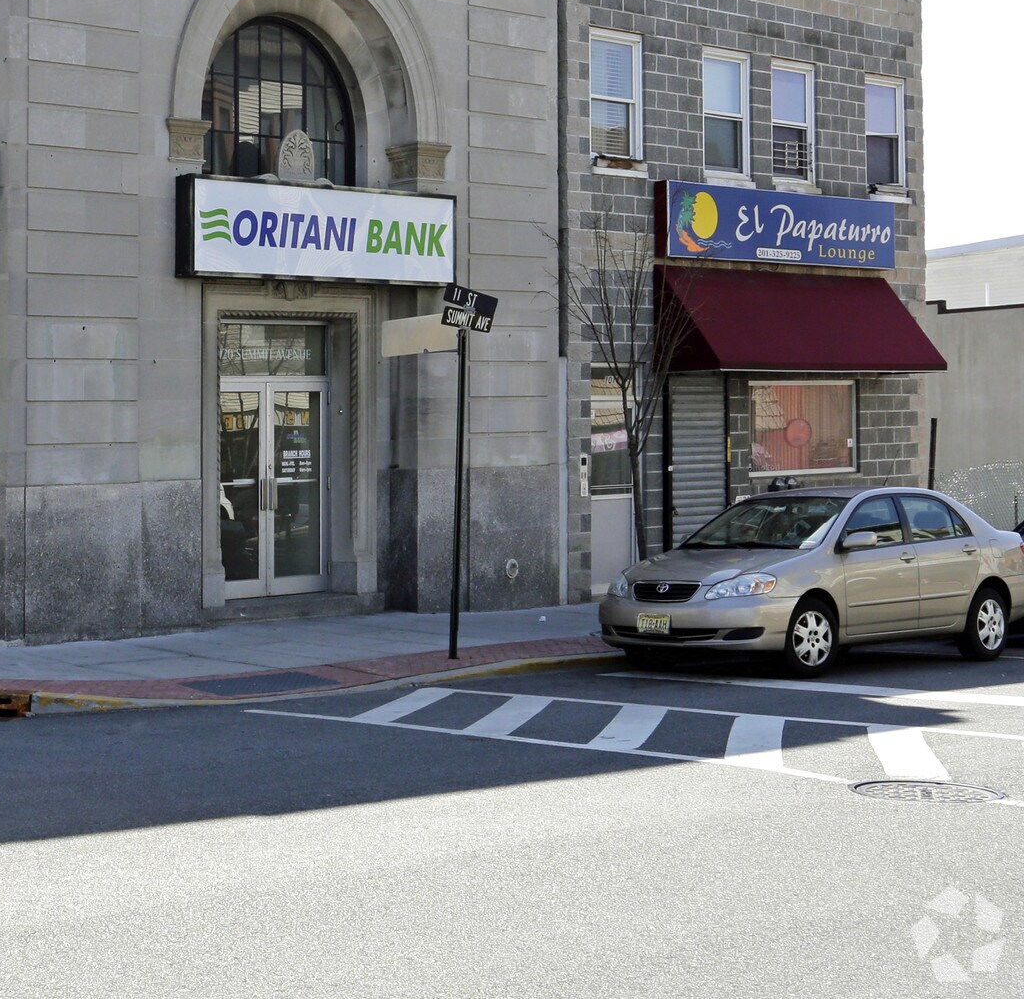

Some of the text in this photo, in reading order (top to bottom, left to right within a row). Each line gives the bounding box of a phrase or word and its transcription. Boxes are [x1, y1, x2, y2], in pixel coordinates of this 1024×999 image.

[232, 209, 448, 258] ORITANI BANK
[735, 204, 891, 252] El Papaturro
[818, 244, 876, 263] Lounge
[466, 292, 478, 308] ST
[446, 309, 491, 331] SUMMIT AVE
[236, 348, 273, 361] SUMMIT
[275, 348, 312, 361] AVENUE
